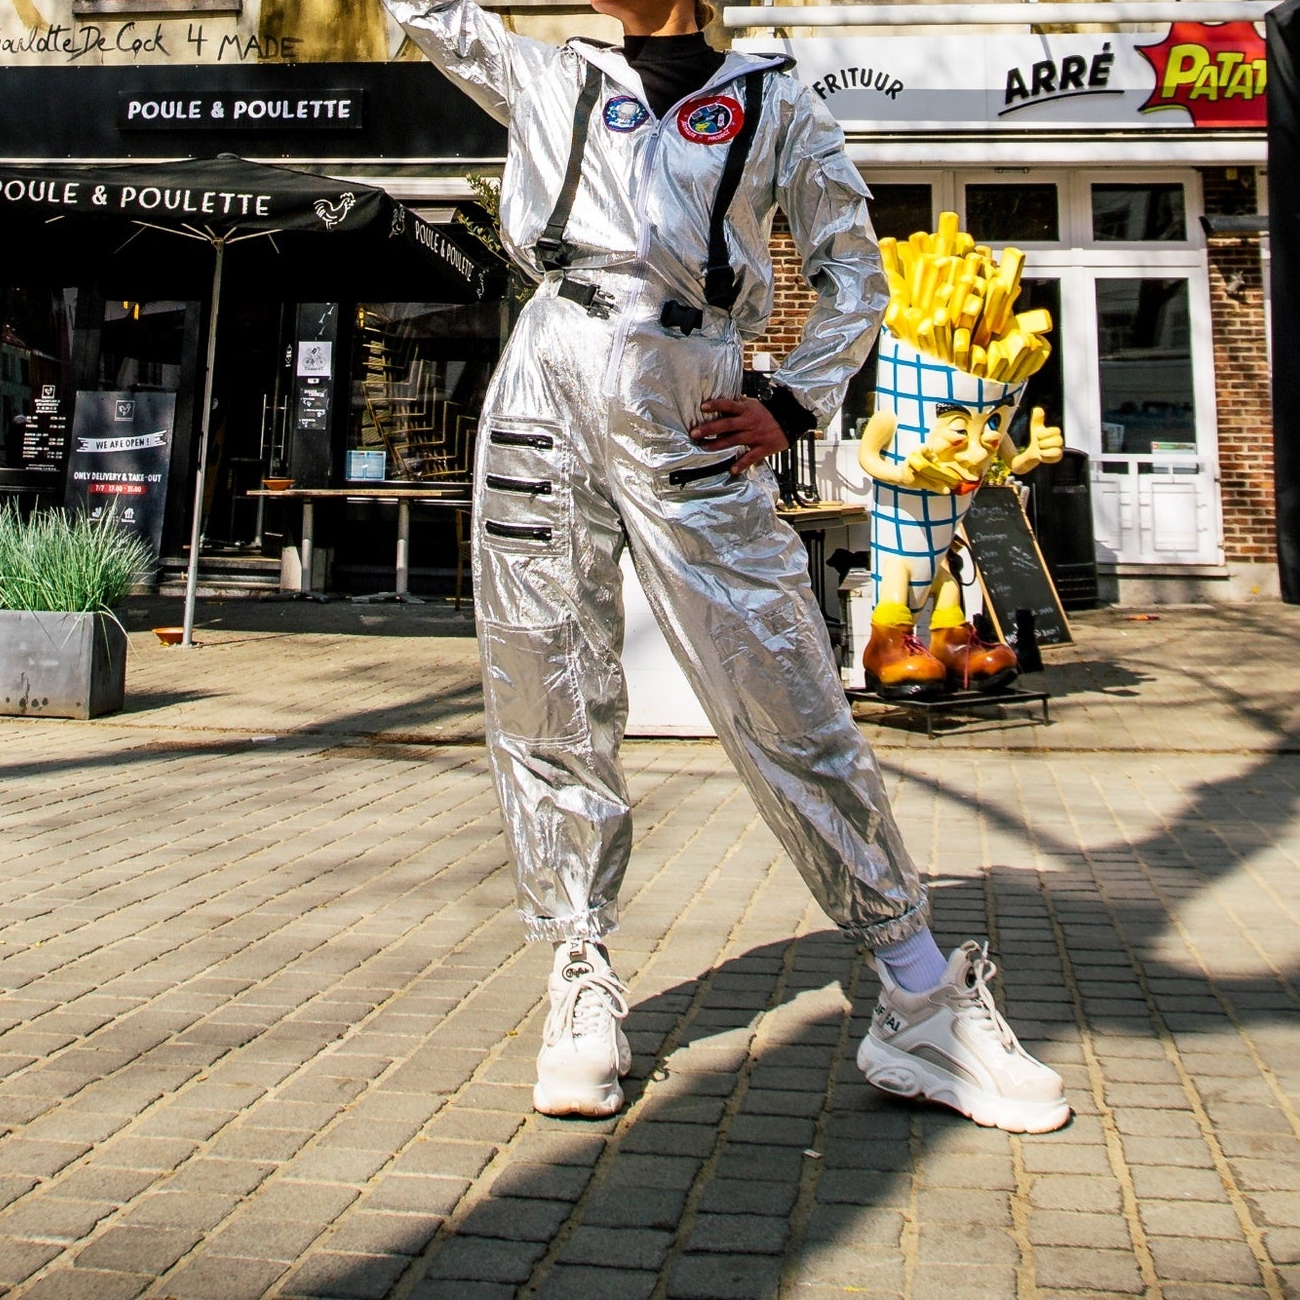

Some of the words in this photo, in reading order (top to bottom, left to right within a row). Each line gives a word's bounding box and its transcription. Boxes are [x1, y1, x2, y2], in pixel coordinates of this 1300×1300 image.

[116, 21, 171, 59] Cock
[187, 23, 208, 56] 4
[217, 34, 304, 61] MADE
[812, 67, 904, 100] FRITUUR
[1004, 41, 1115, 104] ARRÉ
[128, 101, 202, 119] POULE
[211, 101, 224, 118] &
[234, 100, 351, 119] POULETTE
[91, 185, 108, 206] &
[120, 186, 272, 216] POULETTE
[415, 220, 440, 253] POULE
[96, 441, 108, 450] WE
[109, 440, 124, 448] ARE
[125, 438, 145, 448] OPEN
[73, 471, 91, 480] ONLY
[91, 472, 121, 481] DELIVERY
[121, 473, 128, 481] &
